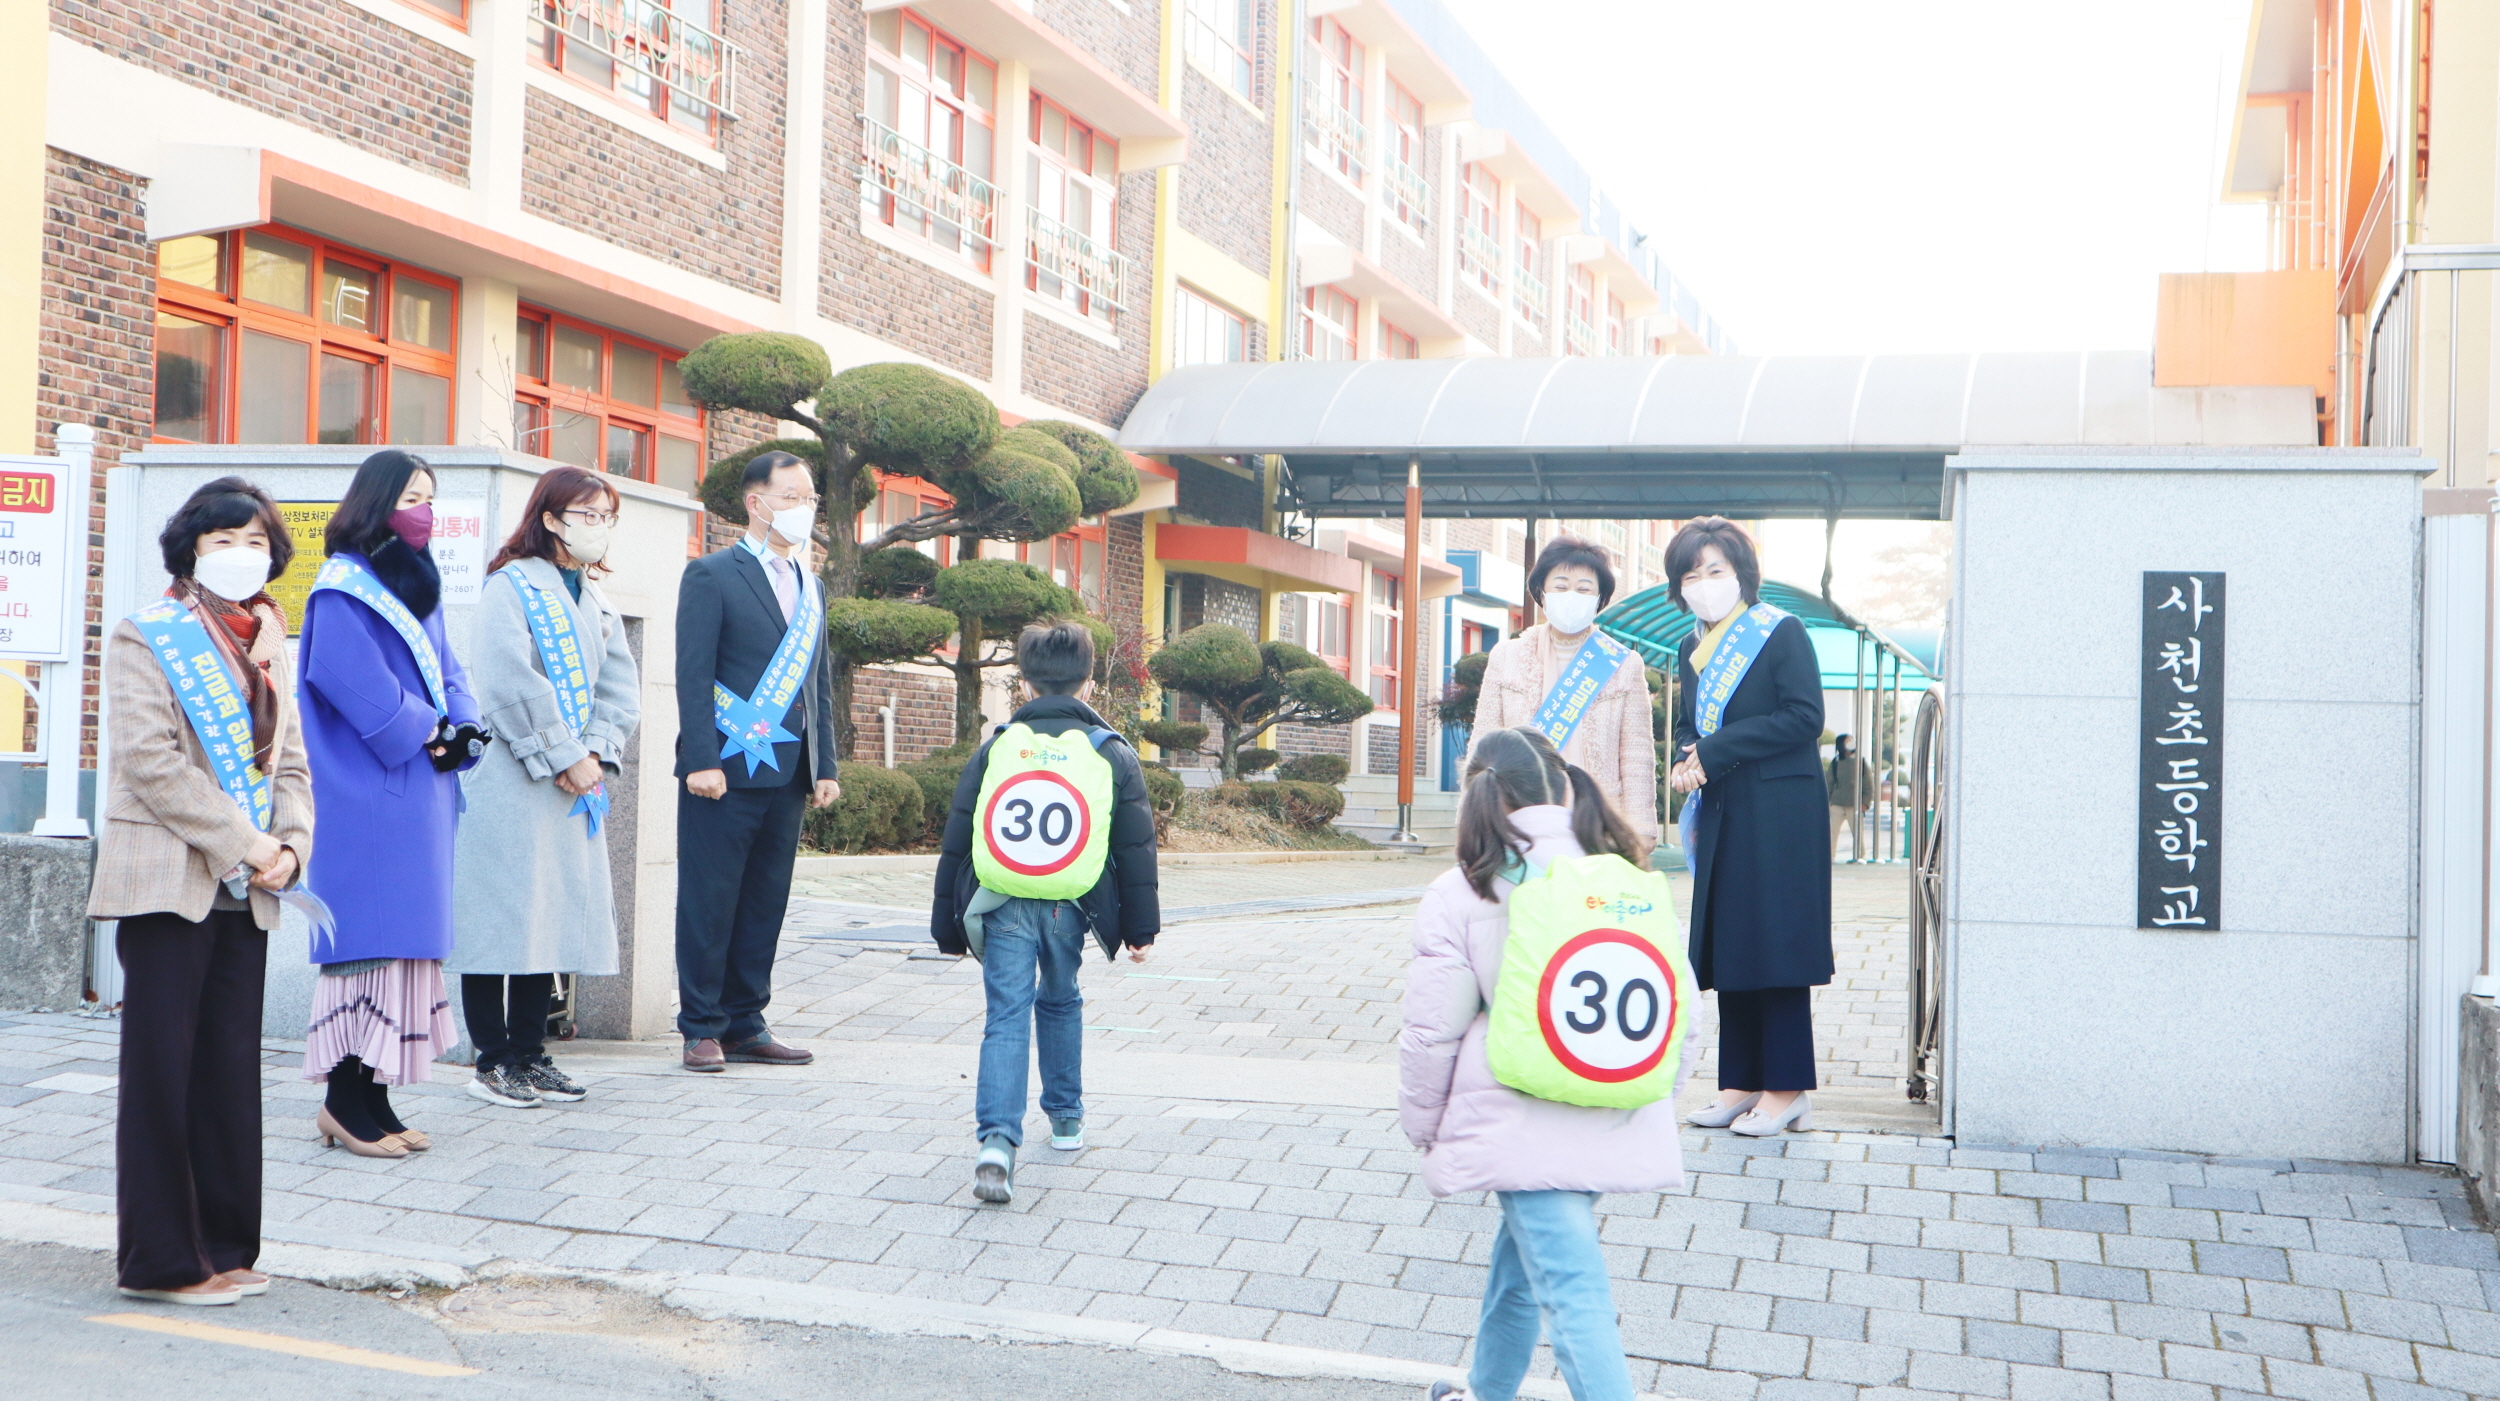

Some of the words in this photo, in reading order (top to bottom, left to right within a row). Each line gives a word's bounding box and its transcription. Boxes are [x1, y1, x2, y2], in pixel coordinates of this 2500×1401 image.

[0, 476, 47, 508] 금지
[281, 510, 336, 522] 상정보처리
[431, 517, 480, 537] 입통제
[379, 590, 422, 638] 진급과
[539, 589, 571, 635] 진급과
[558, 635, 586, 688] 입학을
[1714, 624, 1746, 665] 여러분의
[190, 651, 241, 720] 진급과
[533, 614, 554, 648] 건강한
[547, 652, 563, 675] 학교
[556, 678, 574, 714] 생활을
[1563, 650, 1595, 687] 여러분의
[1700, 667, 1720, 702] 건강한
[1711, 651, 1749, 703] 진급과
[155, 634, 196, 692] 여러분의
[188, 693, 222, 738] 건강한
[213, 743, 237, 772] 학교
[1543, 688, 1568, 721] 건강한
[1559, 675, 1599, 724] 진급과
[1701, 702, 1720, 738] 입학
[1020, 749, 1067, 766] 아이좋아
[2152, 577, 2213, 927] 사천초등학교
[1001, 798, 1073, 846] 30
[1565, 970, 1659, 1042] 30
